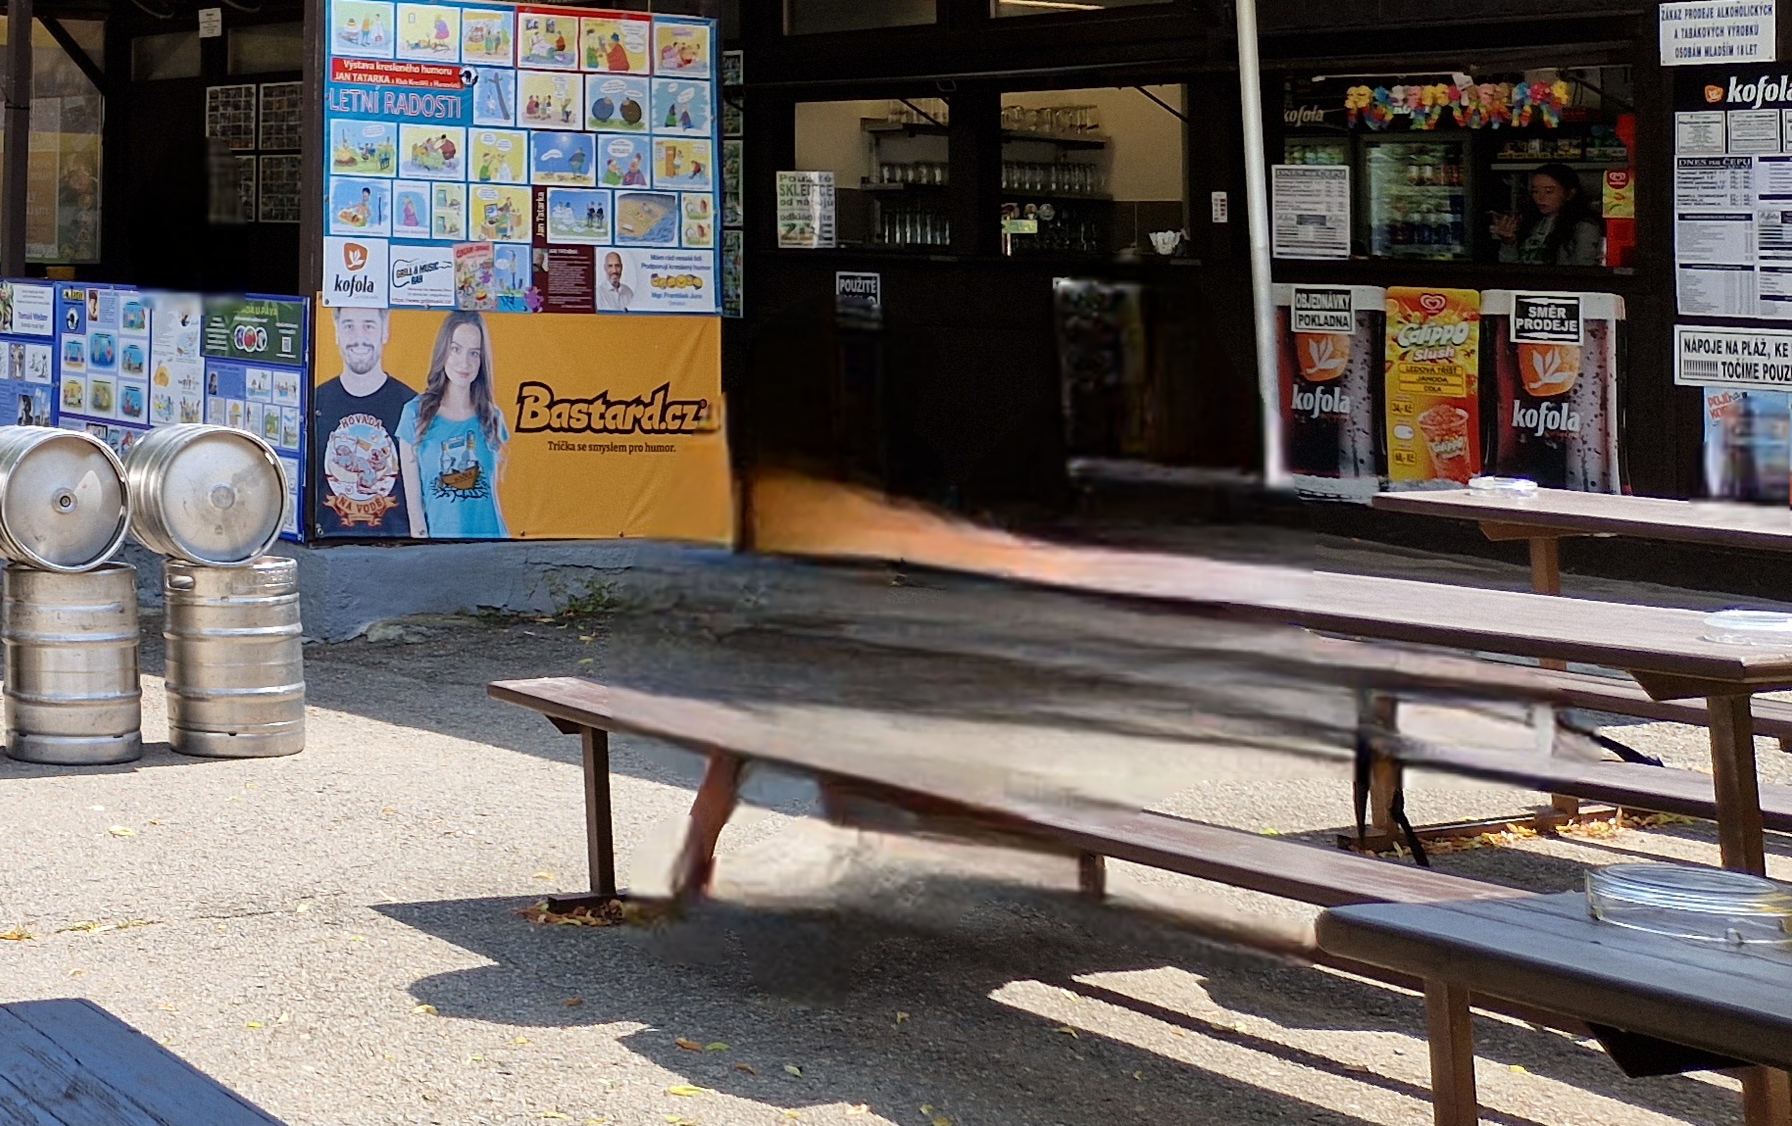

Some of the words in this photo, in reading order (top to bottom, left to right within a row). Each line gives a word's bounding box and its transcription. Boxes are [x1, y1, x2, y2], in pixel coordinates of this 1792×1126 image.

[1661, 6, 1682, 21] ZÁKAZ
[1684, 7, 1714, 20] PRODEJE
[1716, 1, 1773, 18] ALKOHOLICKÝCH
[1675, 43, 1702, 58] OSOBÁM
[1704, 42, 1734, 57] MLADŠÍM
[1745, 43, 1758, 55] LET
[343, 60, 374, 71] Výstava
[376, 63, 420, 73] kresleného
[421, 66, 452, 75] humoru
[335, 71, 351, 80] JAN
[352, 73, 391, 83] TATARKA
[329, 86, 380, 112] LETNÍ
[384, 92, 462, 119] RADOSTI
[334, 274, 375, 297] kofola
[839, 277, 876, 294] POUŽITÉ
[1527, 304, 1566, 320] SMĚR
[1298, 314, 1349, 327] POKLADNA
[1516, 317, 1578, 333] PRODEJE
[1684, 335, 1722, 355] NÁPOJE
[1725, 340, 1738, 356] NA
[1741, 338, 1771, 360] PLÁŽ,
[1774, 342, 1789, 358] KE
[1721, 358, 1760, 380] TOČÍME
[1762, 363, 1792, 382] POUZ
[515, 381, 706, 434] Bastard.cz
[1292, 385, 1352, 418] kofola
[339, 414, 383, 430] HOVADA
[1512, 400, 1581, 436] kofola
[548, 441, 576, 452] Trička
[577, 444, 587, 452] se
[588, 443, 627, 454] smyslem
[628, 445, 644, 455] pro
[645, 444, 677, 453] humor.
[338, 498, 354, 512] NA
